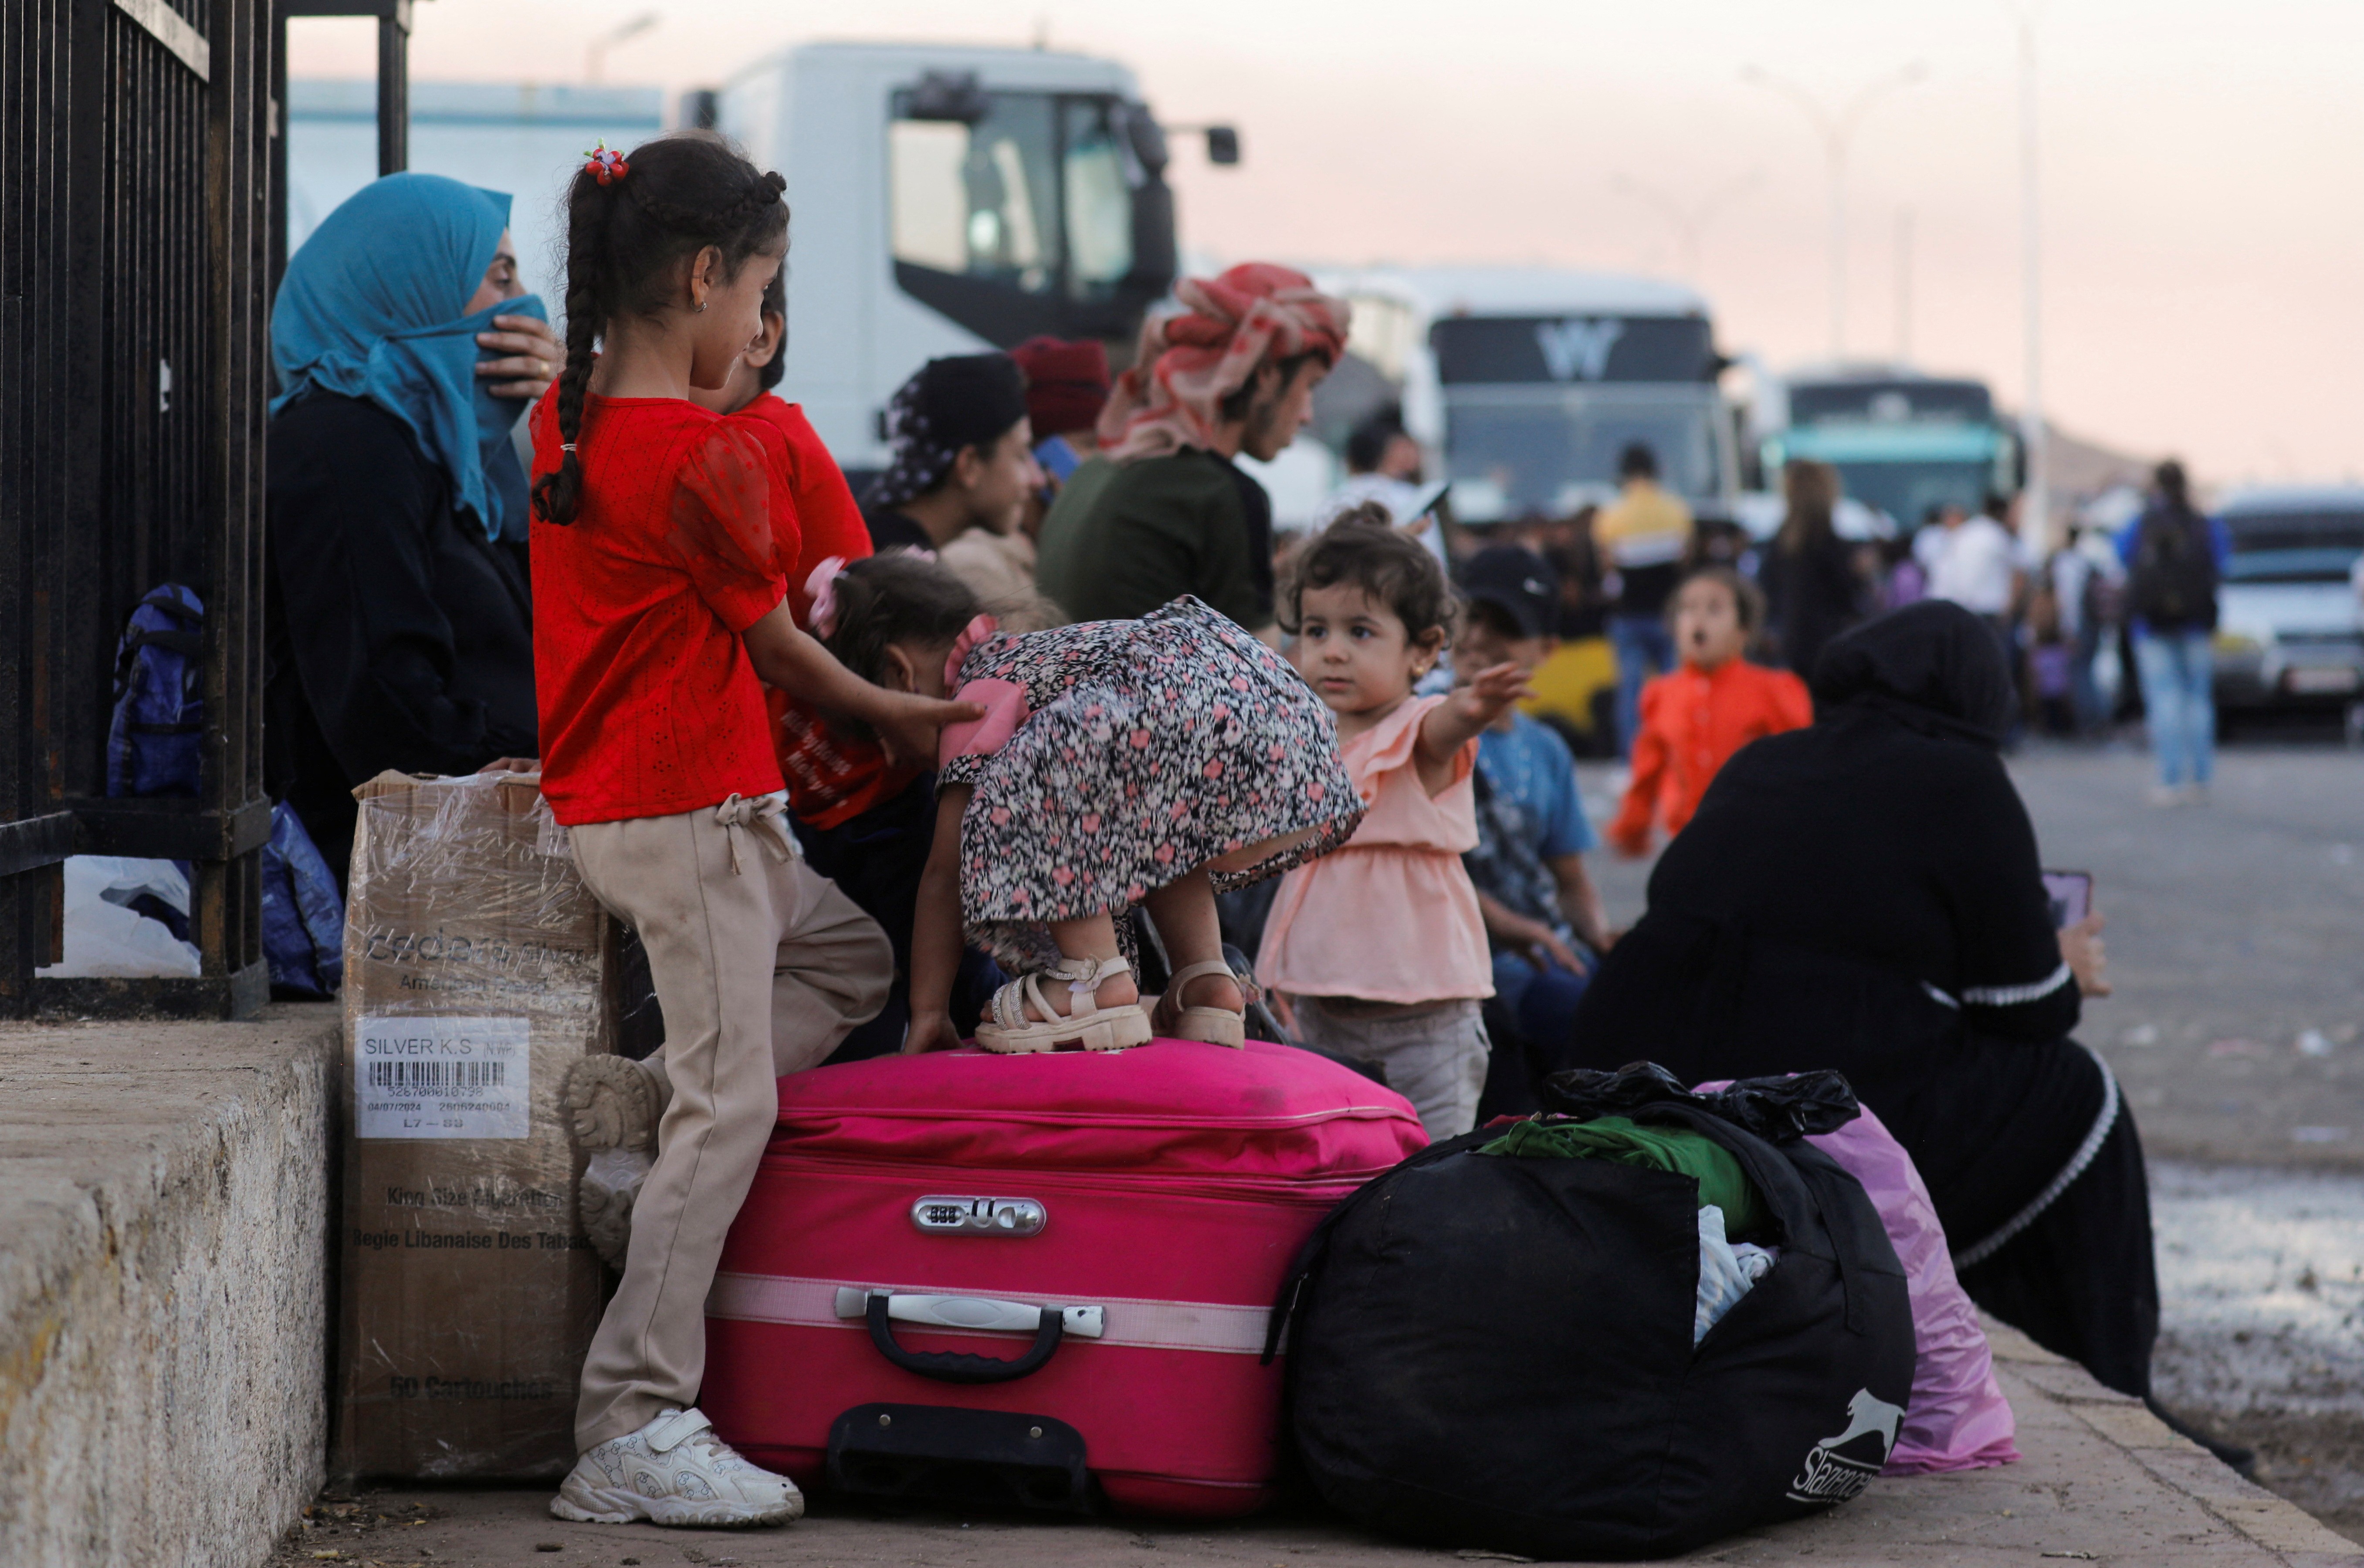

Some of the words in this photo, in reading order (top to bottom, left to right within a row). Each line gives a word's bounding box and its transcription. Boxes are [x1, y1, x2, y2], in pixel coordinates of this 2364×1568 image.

[400, 975, 488, 991] American
[365, 1038, 433, 1055] SILVER
[440, 1039, 472, 1055] K.S
[368, 1103, 421, 1111] 04/07/2024
[403, 1119, 422, 1128] L7
[387, 1186, 425, 1207] King
[431, 1188, 467, 1206] Size
[353, 1229, 399, 1250] Regie
[405, 1230, 492, 1249] Libanaise
[498, 1231, 532, 1250] Des
[425, 1376, 553, 1400] Cartouches
